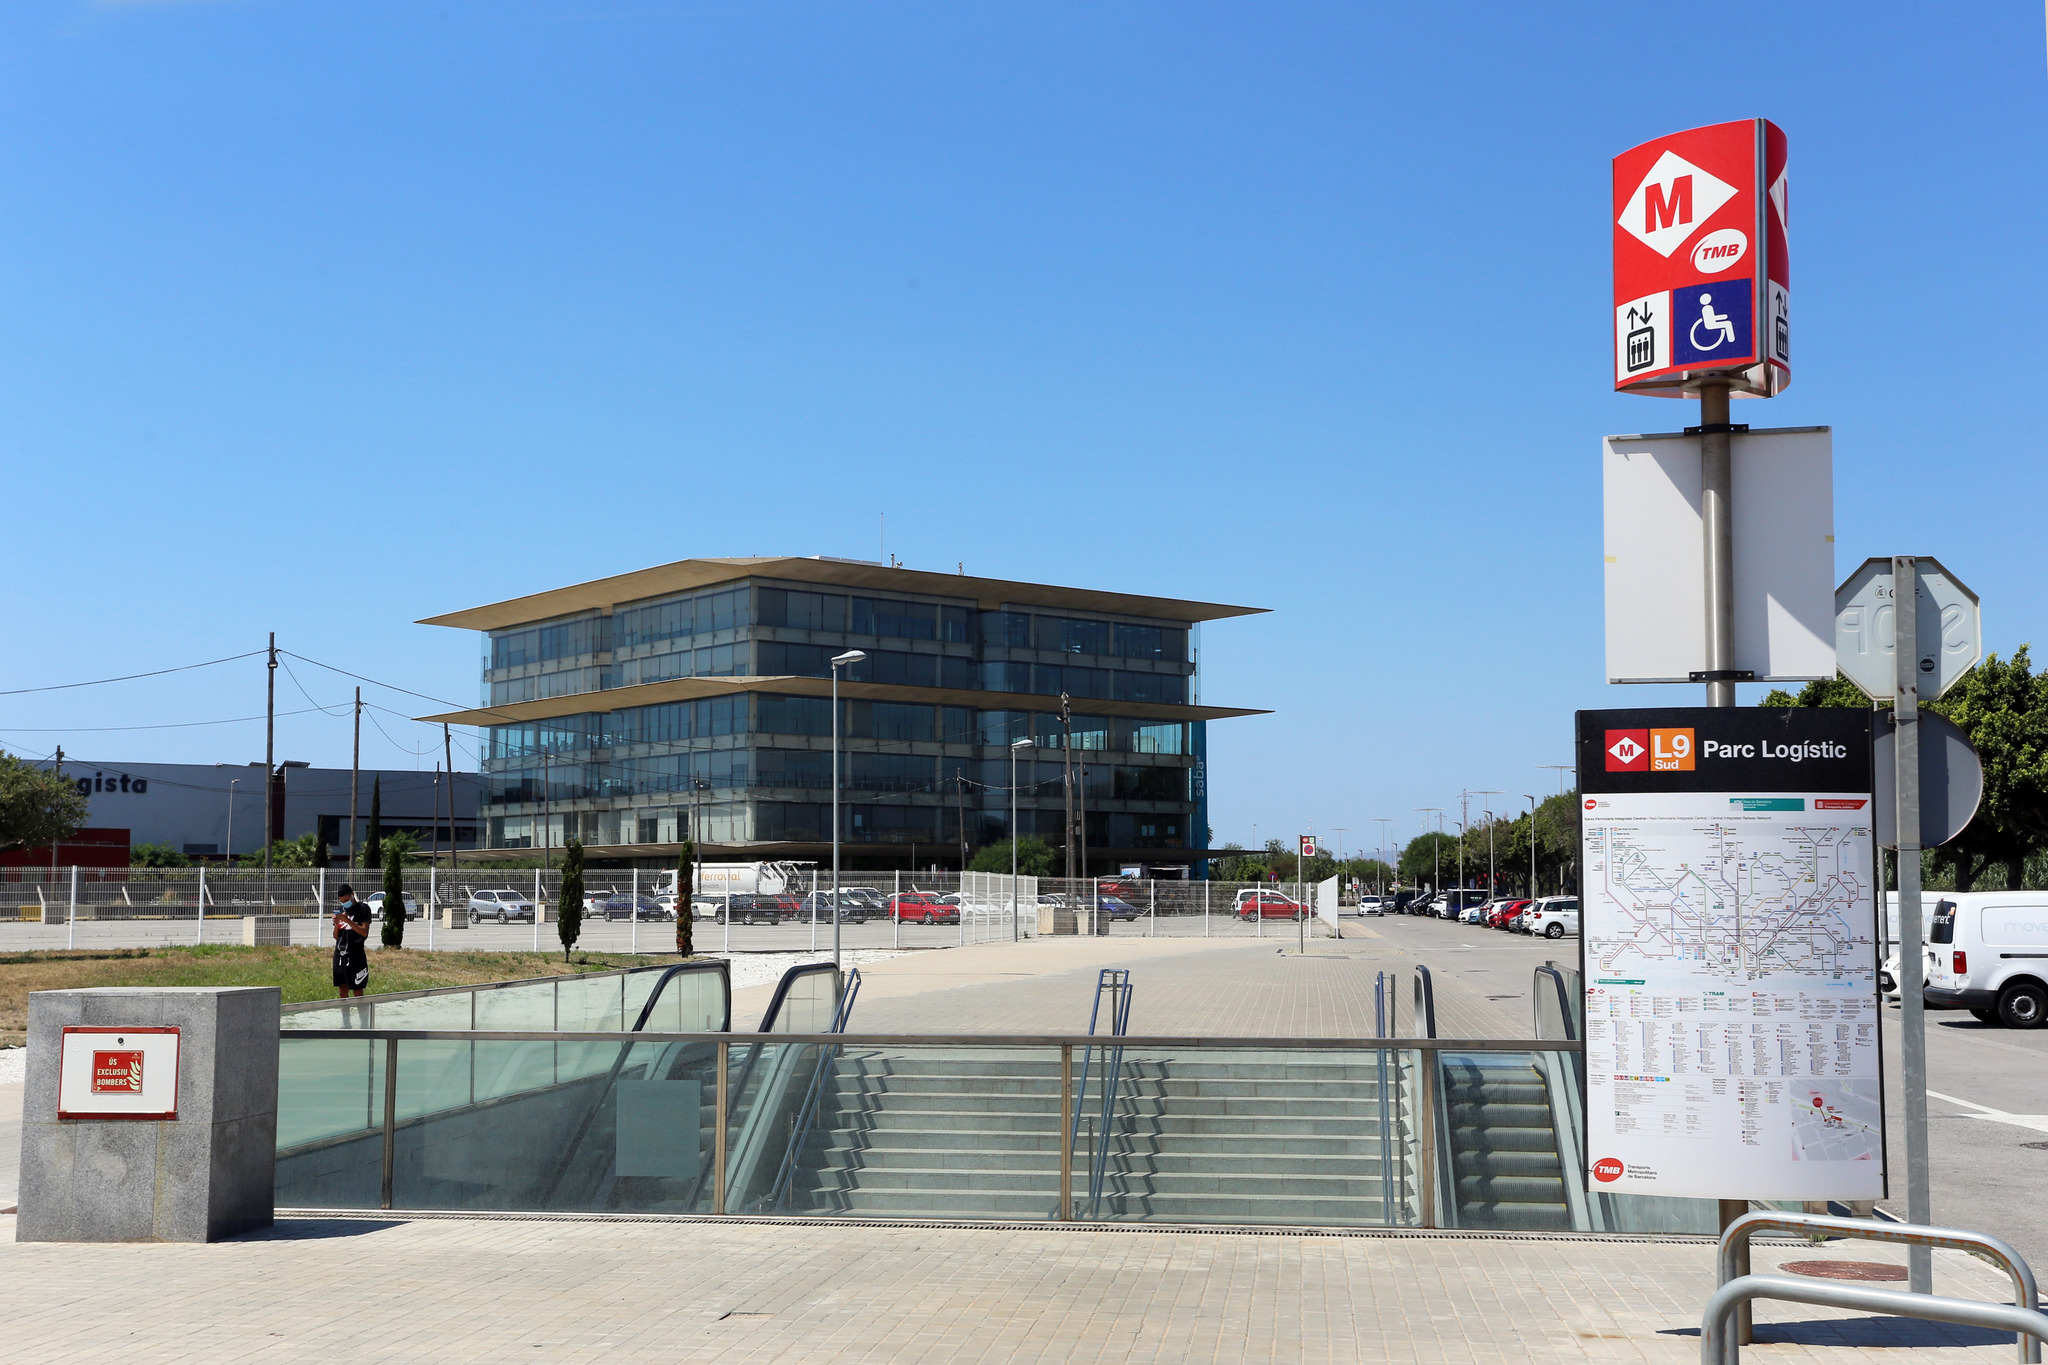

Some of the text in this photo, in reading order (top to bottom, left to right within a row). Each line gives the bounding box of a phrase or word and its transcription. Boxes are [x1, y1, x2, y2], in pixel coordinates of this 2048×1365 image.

[1645, 174, 1693, 234] M
[1702, 243, 1740, 260] TMB
[1619, 744, 1634, 757] M
[1654, 734, 1690, 759] L9
[1703, 740, 1847, 762] Parc Logístic
[1654, 759, 1679, 770] Sud
[1193, 761, 1204, 797] saba
[701, 870, 741, 881] ferroval
[356, 967, 368, 980] NIKE
[108, 1056, 118, 1066] ÚS
[97, 1068, 128, 1076] EXCLUSIU
[96, 1078, 127, 1086] BOMBERS
[1599, 1166, 1621, 1175] TMB
